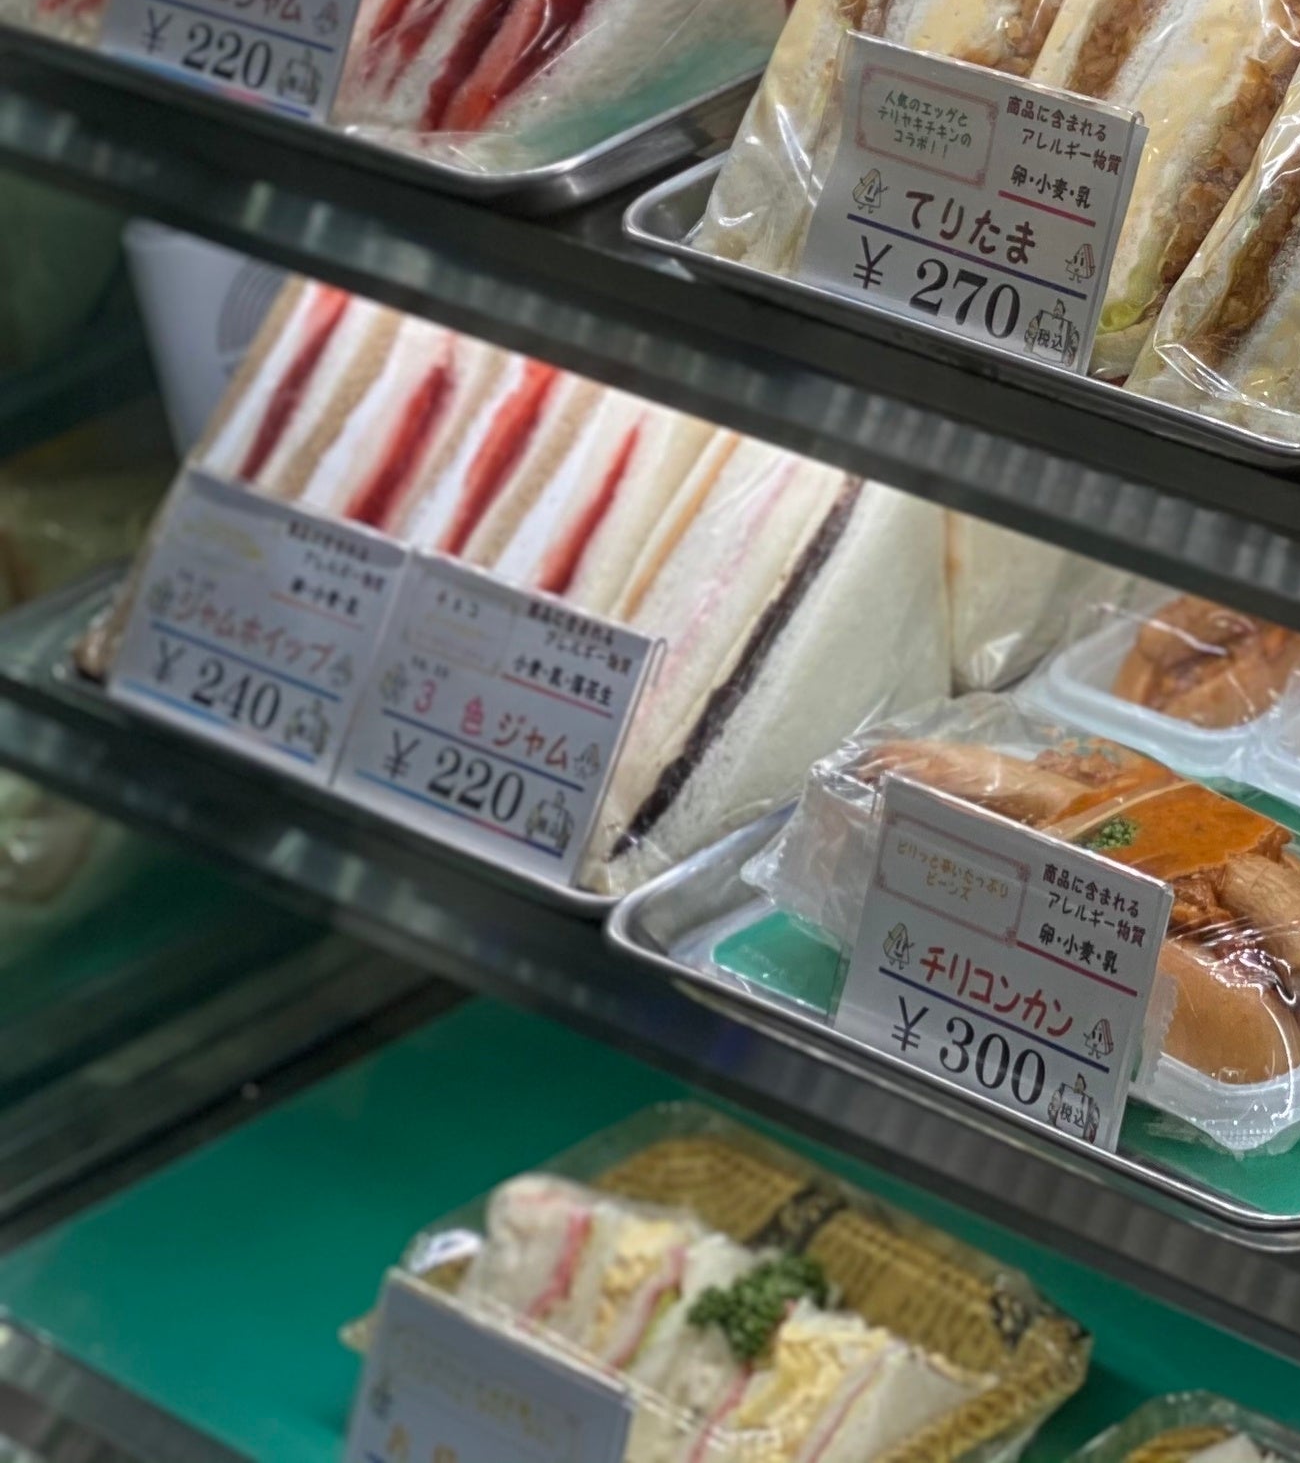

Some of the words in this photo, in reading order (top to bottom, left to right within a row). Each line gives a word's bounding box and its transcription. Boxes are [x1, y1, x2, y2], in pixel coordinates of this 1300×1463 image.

[877, 107, 972, 147] テリヤキチキンの
[884, 90, 968, 128] 人気のエッグと
[1006, 95, 1107, 142] 商品に含まれる
[1022, 128, 1122, 176] アレルギー物質
[1010, 164, 1091, 209] 卵・小麦・乳
[905, 190, 1036, 265] てりたま
[1036, 328, 1063, 351] 税込
[1042, 863, 1140, 917] 商品に含まれる
[1047, 892, 1147, 948] アレルギー物質
[1039, 923, 1119, 974] 卵・小麦・乳
[919, 947, 1074, 1038] チリコンカン
[1060, 1102, 1086, 1127] 税込
